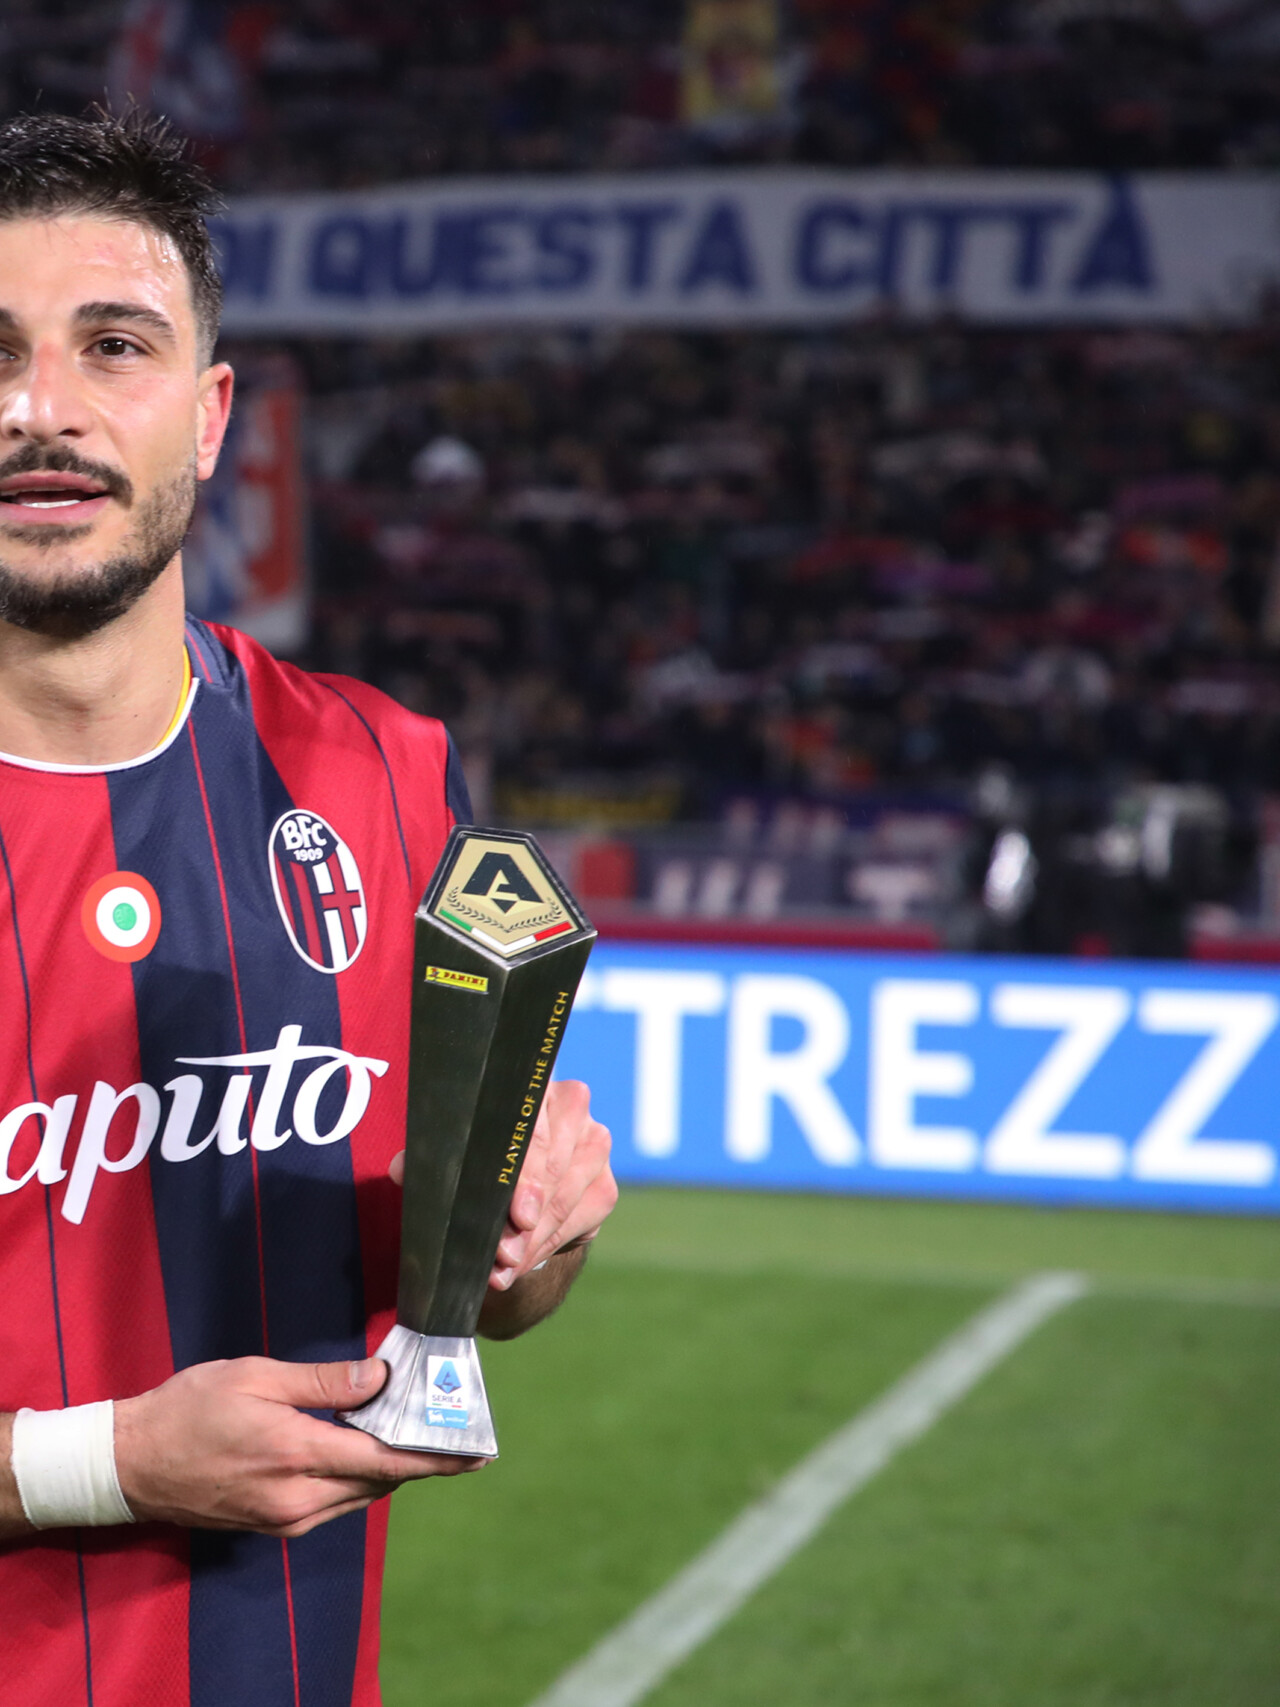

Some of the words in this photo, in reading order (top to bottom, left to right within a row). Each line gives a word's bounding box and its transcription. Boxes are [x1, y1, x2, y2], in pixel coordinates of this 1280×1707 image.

[308, 196, 758, 304] QUESTA
[280, 815, 328, 850] BFC
[293, 847, 324, 862] 1909
[444, 971, 485, 986] PANINI
[541, 991, 570, 1054] MATCH
[528, 1058, 549, 1090] THE
[521, 1094, 536, 1118] OF
[498, 1121, 529, 1185] PLAYER
[431, 1394, 454, 1403] SERIE
